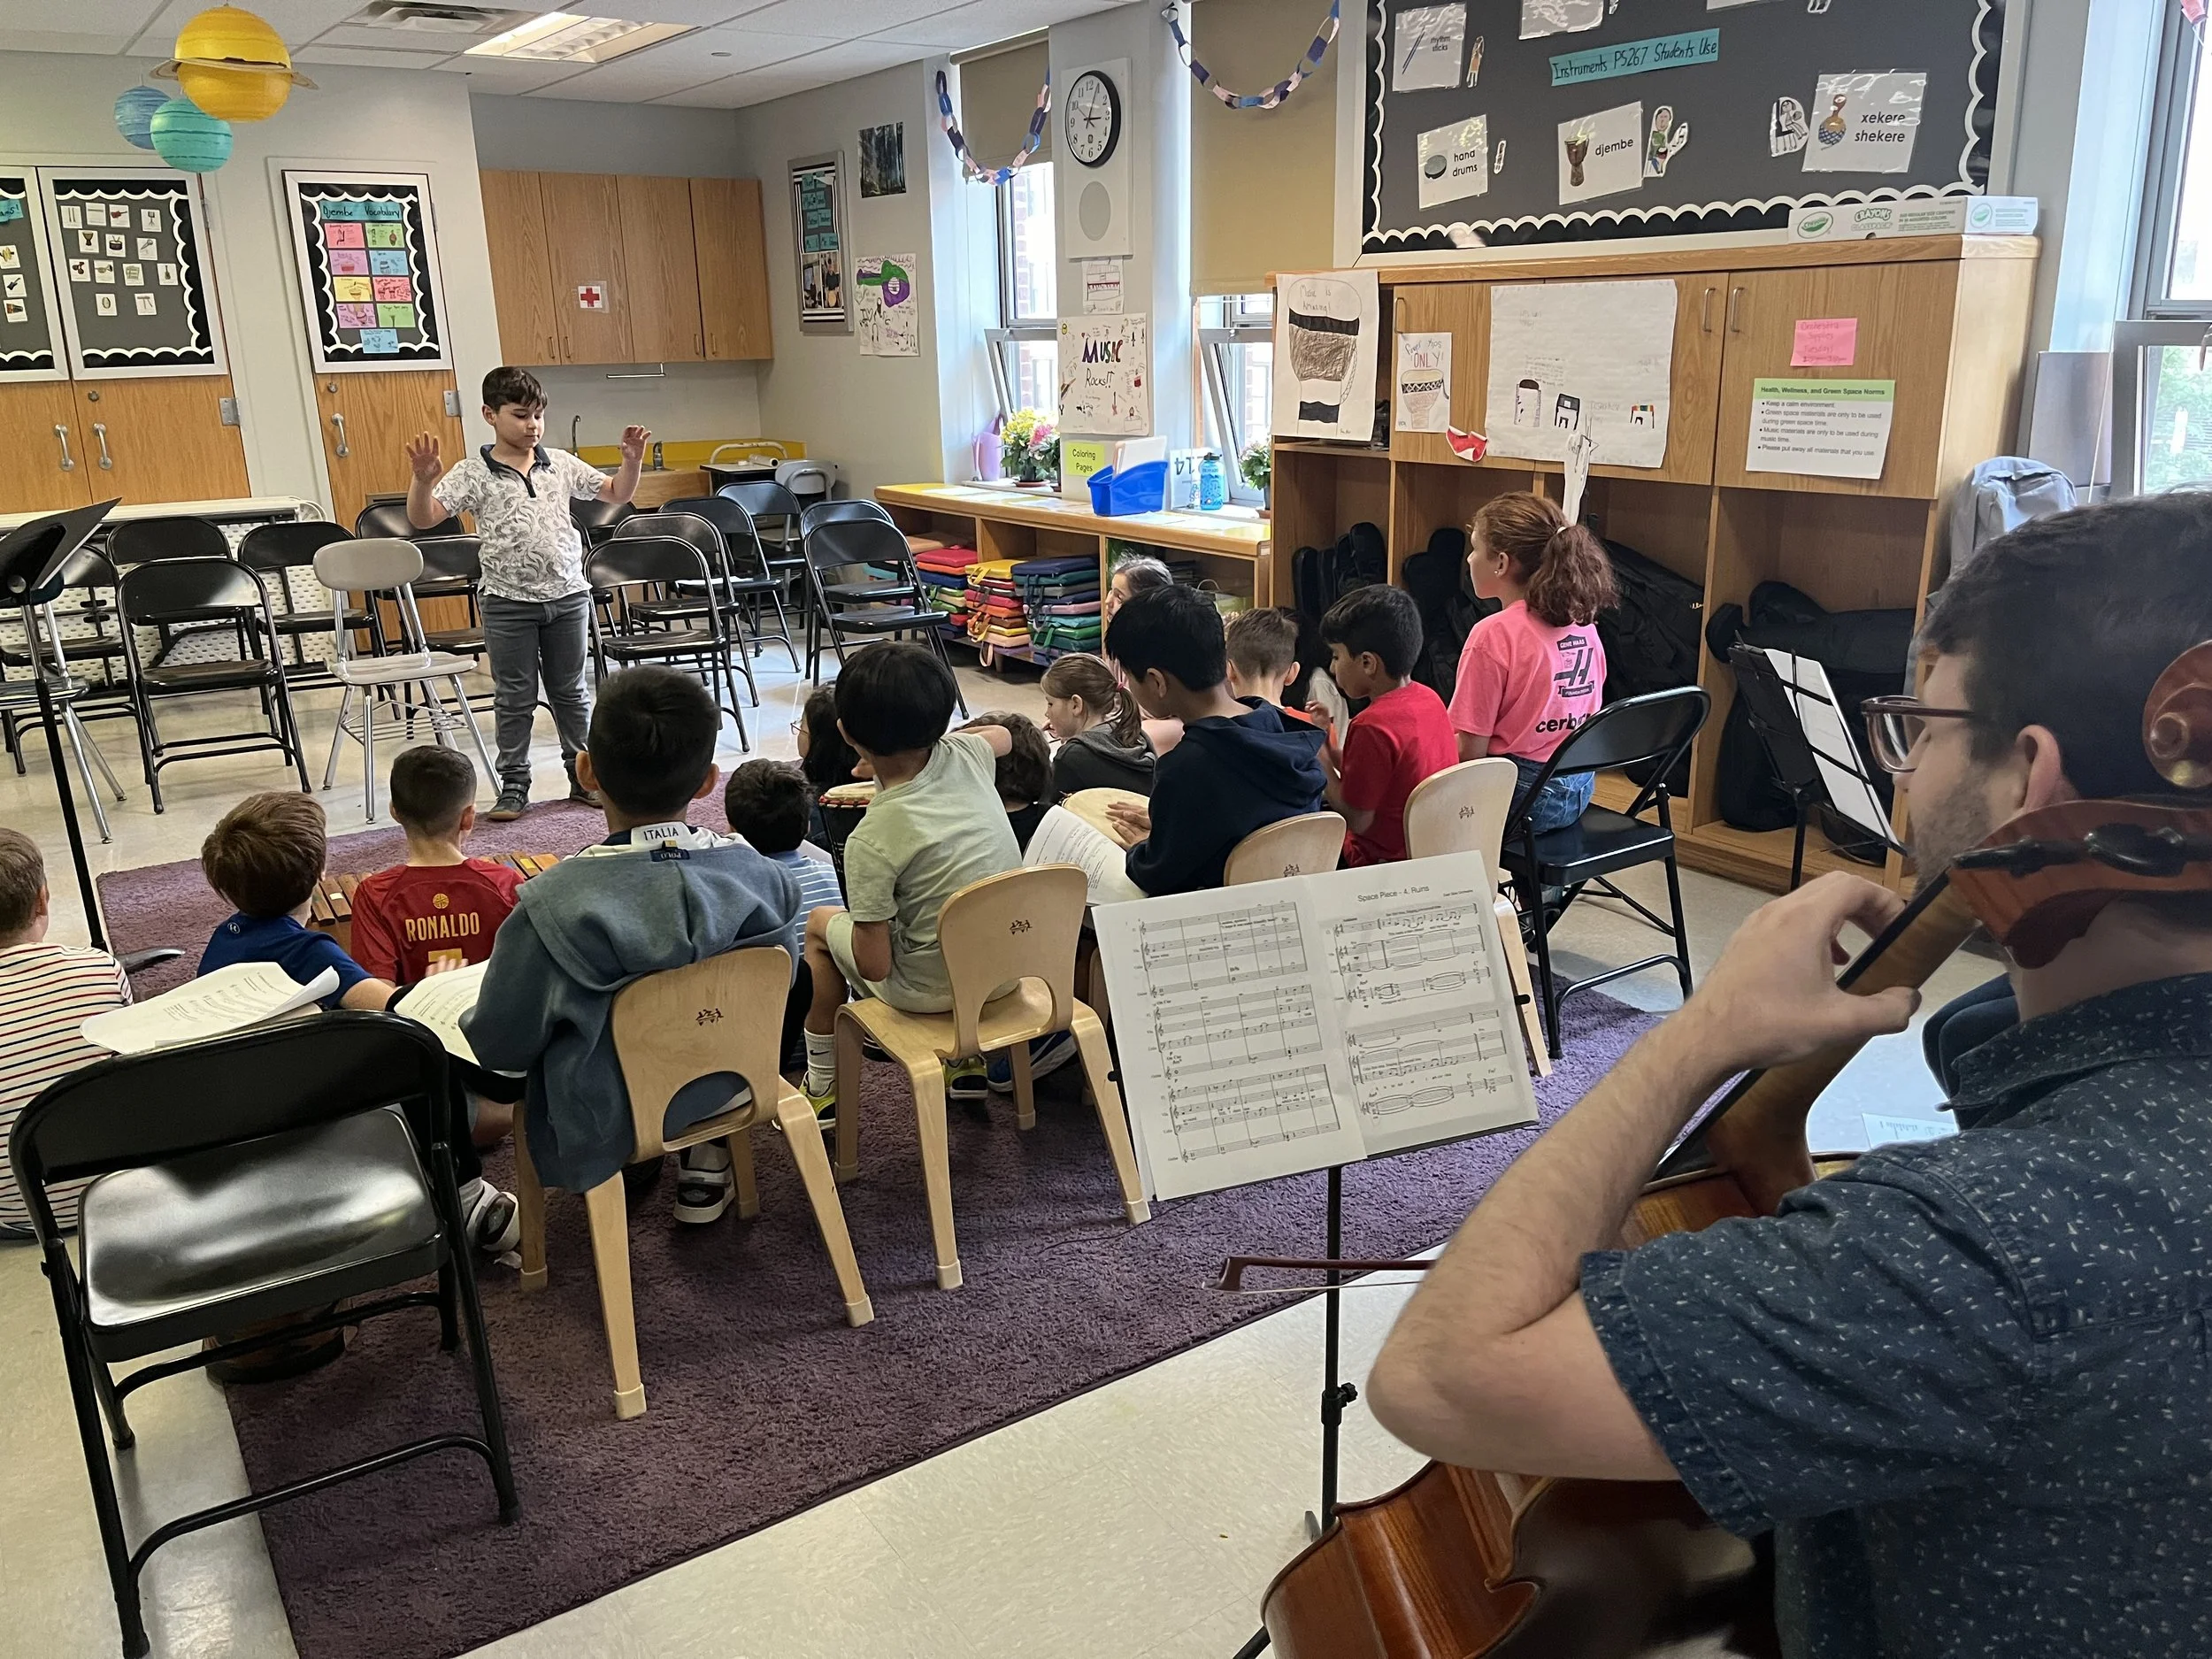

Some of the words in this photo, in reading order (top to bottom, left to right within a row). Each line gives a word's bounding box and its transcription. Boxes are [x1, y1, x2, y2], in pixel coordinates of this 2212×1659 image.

[1552, 55, 1608, 81] Instruments
[1613, 46, 1649, 70] PS267
[1654, 39, 1694, 63] Students
[1698, 37, 1717, 56] Use
[1086, 80, 1094, 91] 12
[1078, 88, 1085, 97] 11
[1071, 100, 1079, 111] 10
[1102, 95, 1108, 105] 2
[1070, 118, 1076, 127] 9
[1861, 111, 1906, 124] xekere
[1073, 134, 1078, 144] 8
[1855, 130, 1906, 142] shekere
[1080, 144, 1085, 155] 7
[1097, 141, 1102, 151] 5
[1594, 138, 1634, 157] djembe
[1088, 148, 1094, 157] 6
[1452, 163, 1478, 177] drums
[322, 205, 354, 219] Djembe
[365, 205, 400, 219] Vocabulary
[1854, 208, 1893, 222] CRAYONS
[1081, 337, 1124, 364] MUSIC
[1071, 449, 1096, 460] Coloring
[1075, 463, 1093, 473] Pages
[643, 826, 680, 841] ITALIA
[1356, 894, 1379, 902] Space
[404, 911, 480, 942] RONALDO
